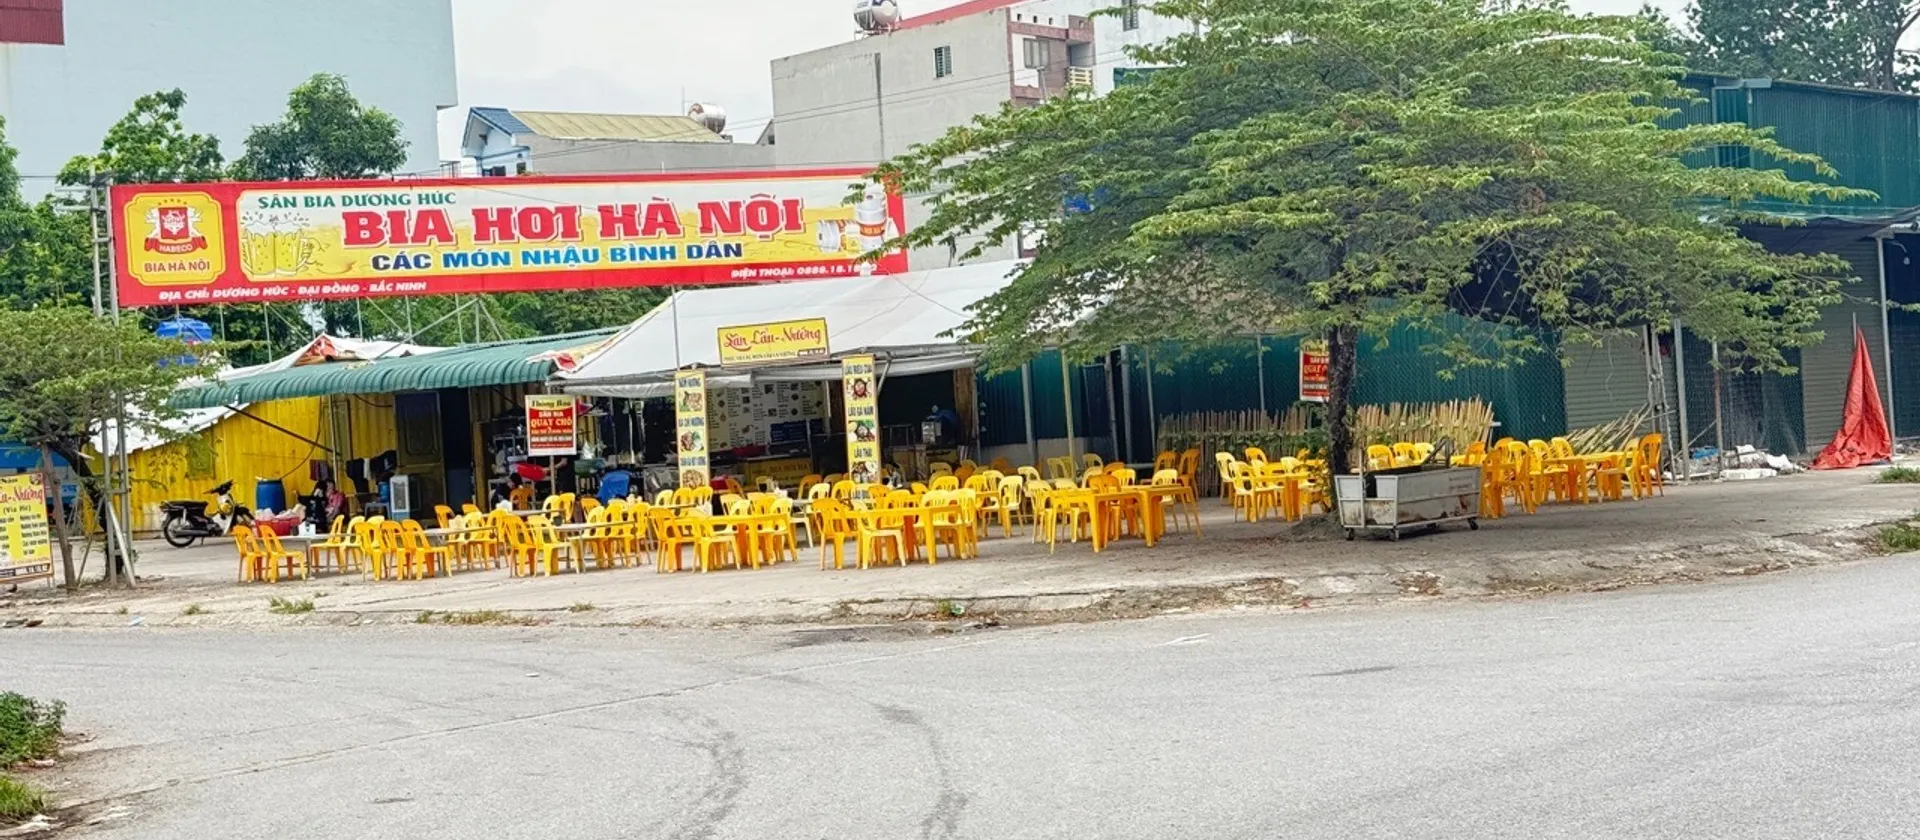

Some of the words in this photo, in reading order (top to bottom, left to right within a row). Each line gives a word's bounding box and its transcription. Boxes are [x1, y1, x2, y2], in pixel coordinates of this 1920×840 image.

[304, 195, 336, 208] BIA
[341, 193, 411, 206] DƯƠNG
[417, 190, 456, 205] HÚC
[341, 208, 456, 246] BIA
[597, 196, 682, 238] HÀ
[697, 193, 802, 240] NỘI
[159, 244, 194, 253] HABECO
[372, 250, 432, 271] CÁC
[442, 248, 511, 268] MÓN
[521, 245, 600, 268] NHẬU
[609, 243, 677, 263] BÌNH
[686, 240, 742, 259] DÂN
[144, 262, 167, 273] BIA
[168, 260, 187, 272] HÀ
[188, 258, 210, 274] NỘI
[730, 267, 757, 279] ĐIỆN
[159, 291, 182, 302] ĐỊA
[213, 286, 260, 298] DƯƠNG
[263, 285, 289, 296] HÚC
[298, 285, 320, 296] ĐẠI
[322, 281, 360, 294] ĐỒNG
[369, 279, 394, 292] BẮC
[396, 282, 427, 291] NINH
